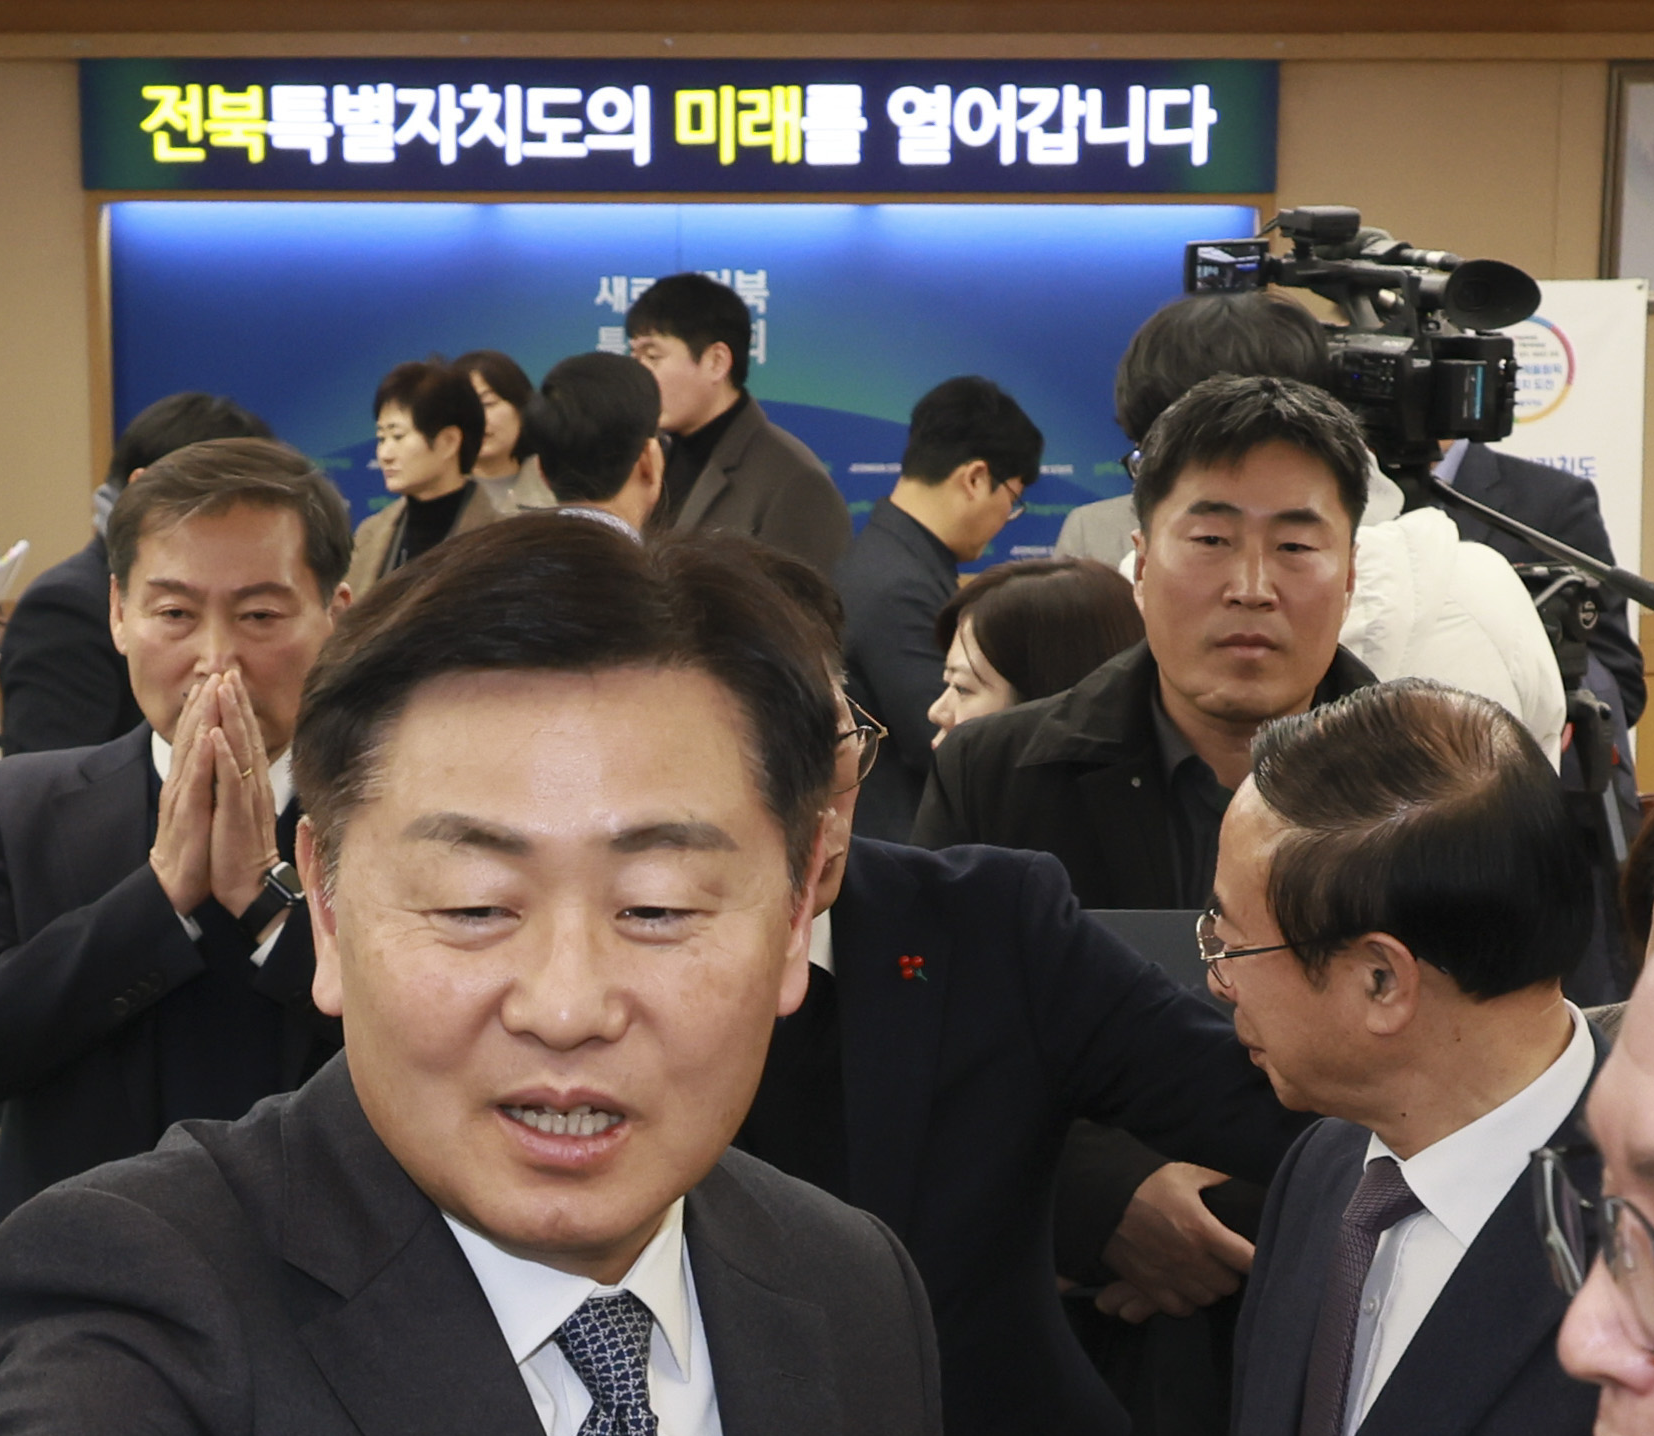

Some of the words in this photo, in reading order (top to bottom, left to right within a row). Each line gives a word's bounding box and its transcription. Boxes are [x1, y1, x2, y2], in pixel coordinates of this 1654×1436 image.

[141, 83, 651, 166] 전북특별자치도의
[674, 84, 868, 166] 미래를
[886, 84, 1218, 167] 열어갑니다
